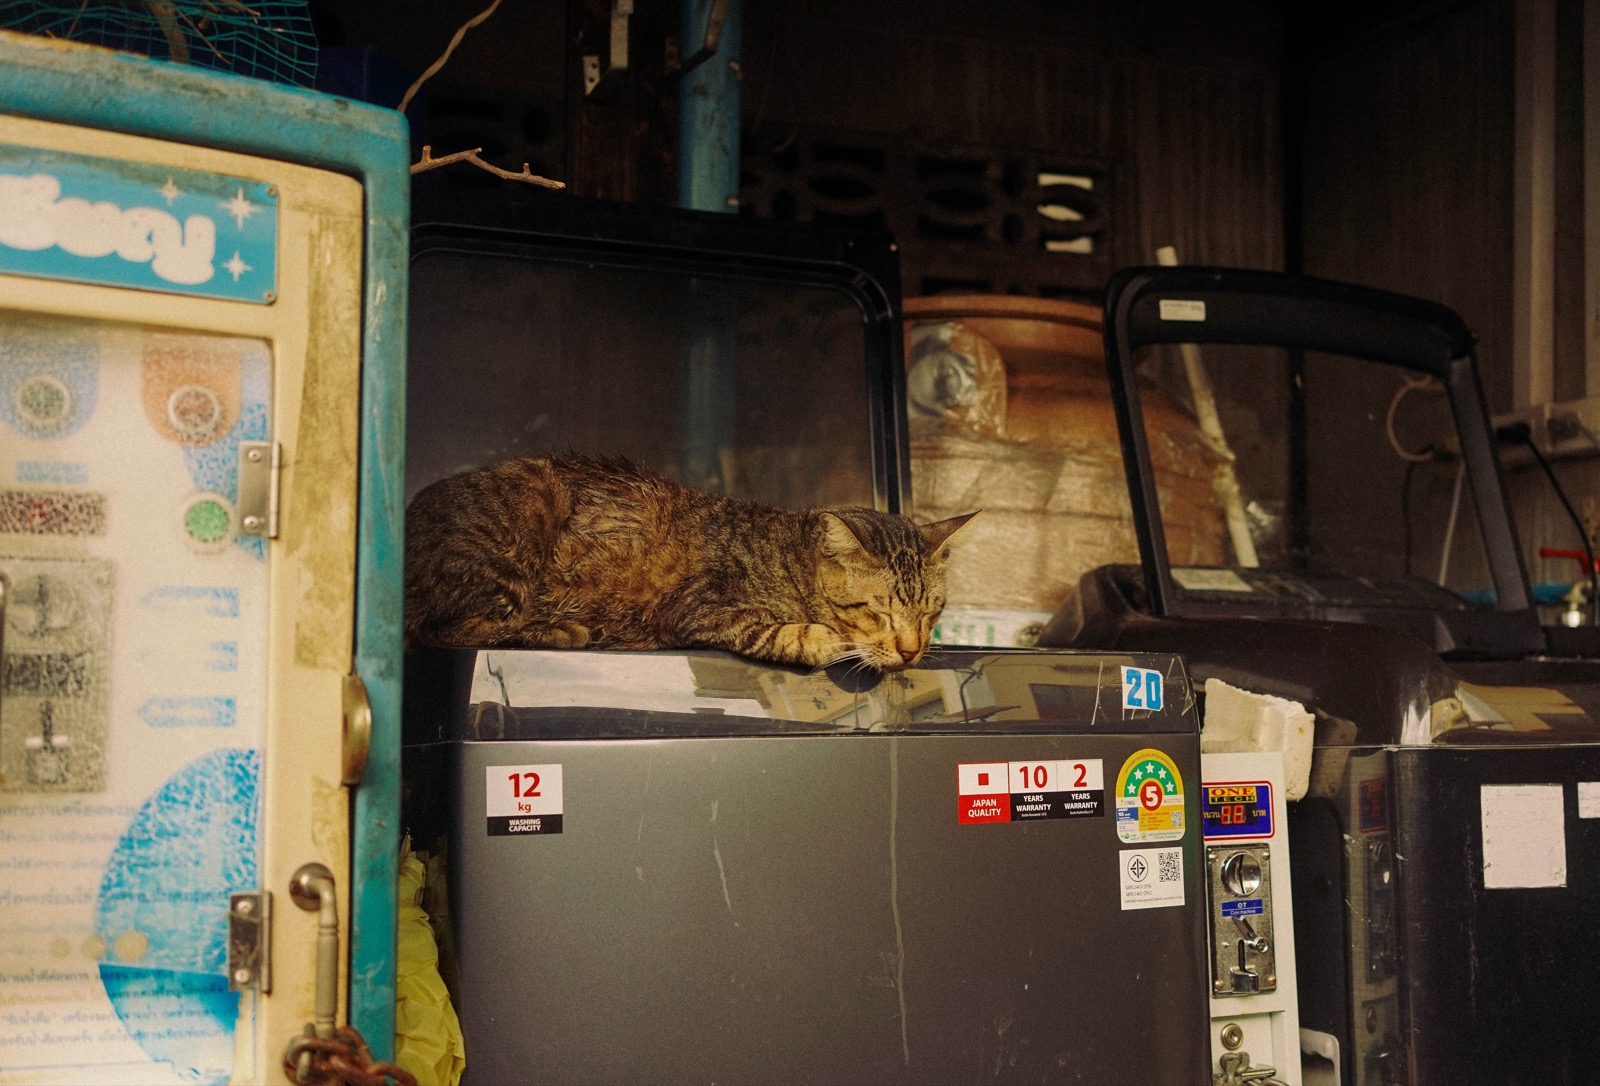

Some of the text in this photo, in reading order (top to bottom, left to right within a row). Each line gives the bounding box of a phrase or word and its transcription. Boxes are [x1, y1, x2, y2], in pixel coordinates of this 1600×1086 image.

[1126, 669, 1161, 710] 20
[1019, 765, 1048, 788] 10
[1073, 763, 1087, 788] 2
[508, 772, 541, 797] 12
[1145, 786, 1159, 807] 5
[1211, 787, 1254, 796] ONE
[518, 802, 531, 813] kg
[972, 799, 997, 808] JAPAN
[1016, 804, 1051, 812] WARRANTY
[1064, 802, 1098, 810] WARRANTY
[968, 808, 1001, 817] QUALITY
[508, 818, 541, 826] WASHING
